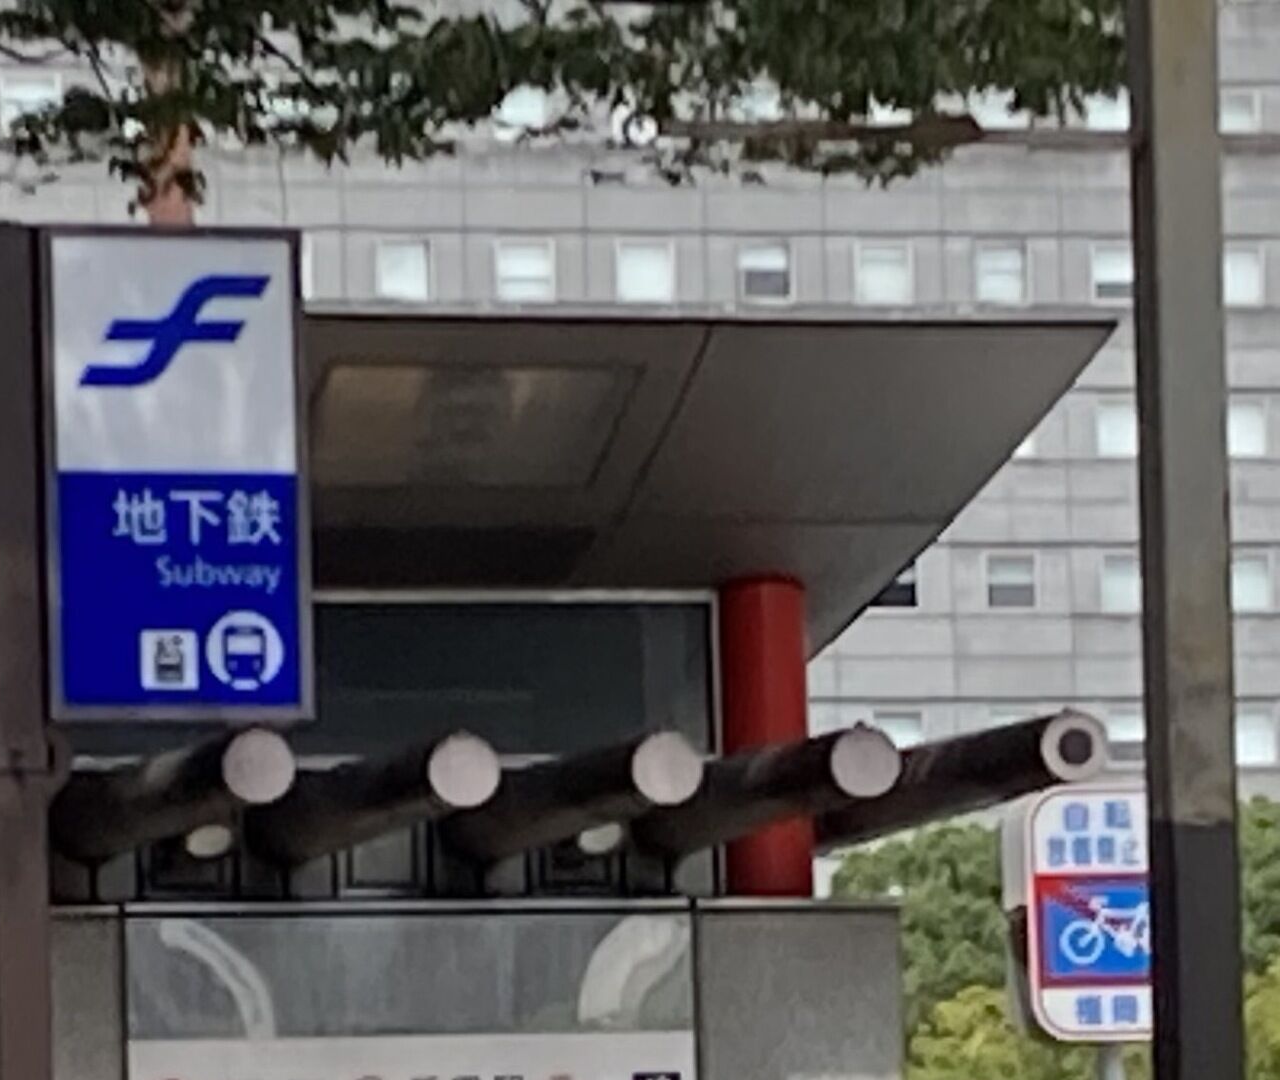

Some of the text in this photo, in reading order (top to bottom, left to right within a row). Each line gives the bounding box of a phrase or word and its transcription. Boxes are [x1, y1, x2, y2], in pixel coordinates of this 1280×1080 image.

[111, 487, 282, 546] 地下鉄
[155, 555, 282, 595] Subway
